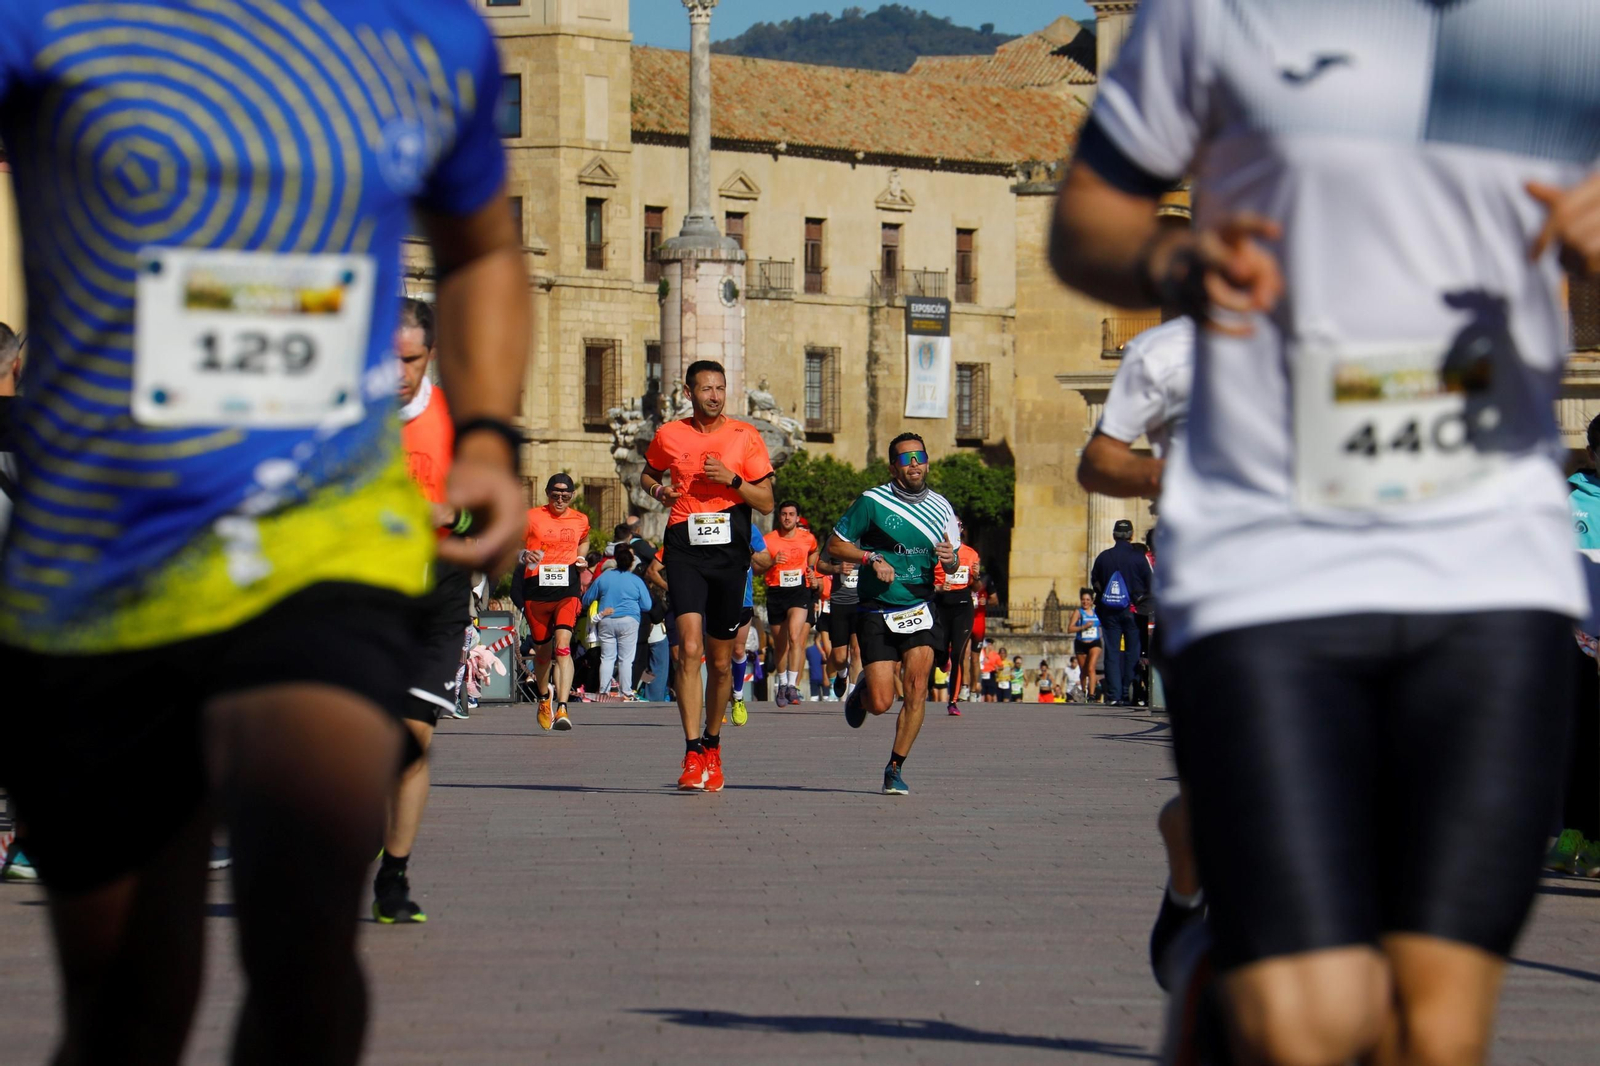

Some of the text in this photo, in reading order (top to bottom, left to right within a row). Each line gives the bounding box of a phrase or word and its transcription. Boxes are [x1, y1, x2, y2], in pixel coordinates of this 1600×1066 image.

[911, 303, 946, 314] EXPOSICIÓN
[197, 331, 317, 374] 129
[697, 526, 721, 536] 124
[545, 573, 564, 581] 355
[897, 617, 922, 629] 230
